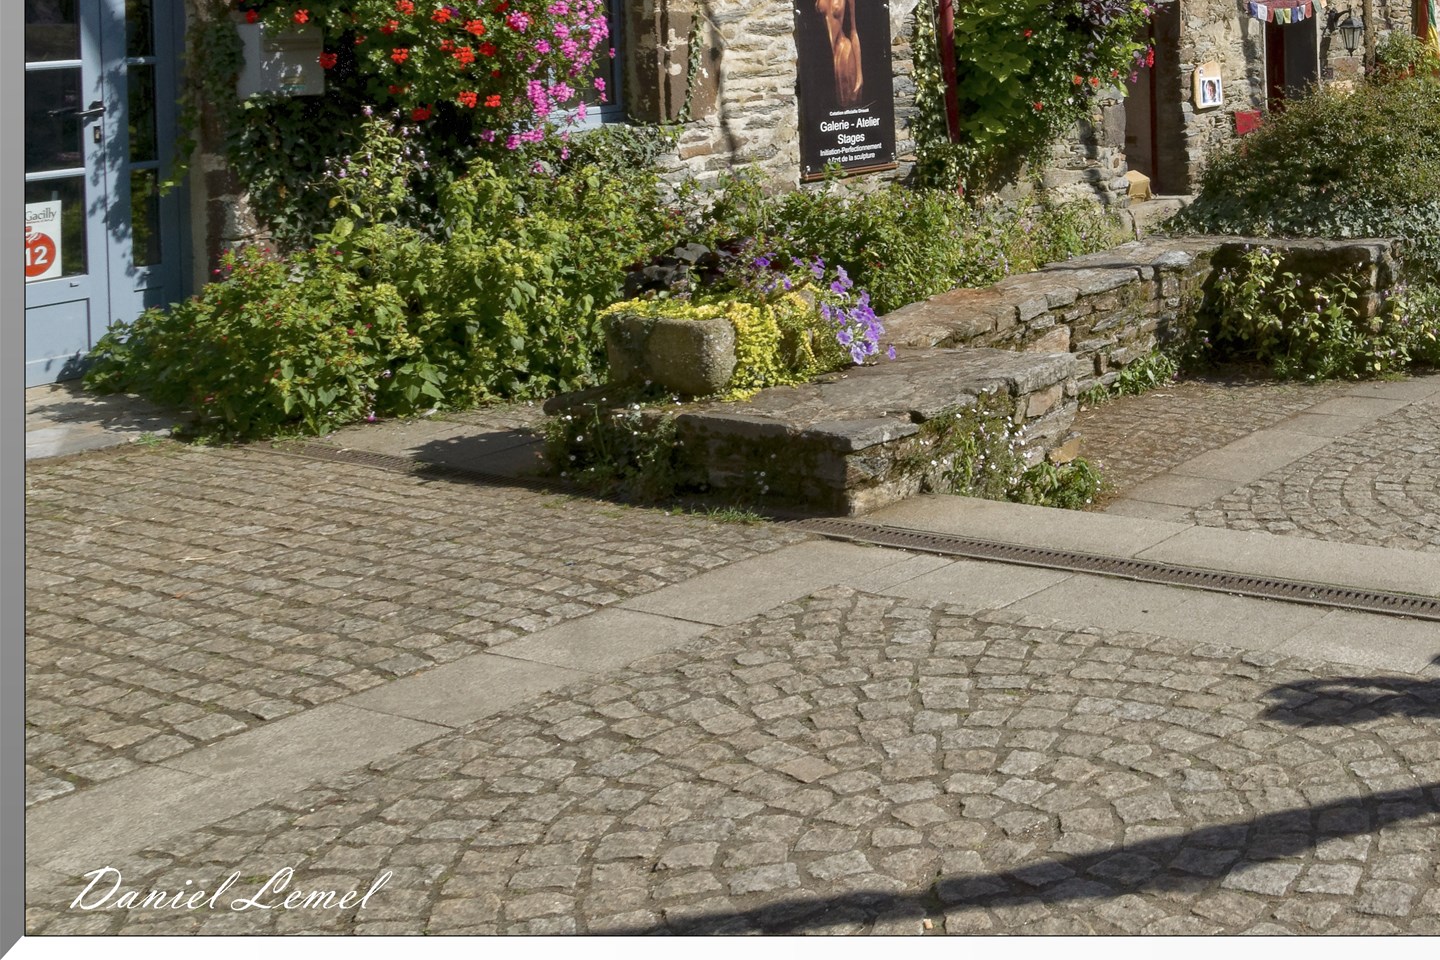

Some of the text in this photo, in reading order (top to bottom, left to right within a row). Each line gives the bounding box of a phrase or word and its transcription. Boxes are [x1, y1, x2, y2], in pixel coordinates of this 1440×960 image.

[820, 119, 850, 133] Galerie
[856, 116, 880, 129] Atelier
[837, 133, 866, 146] Stages
[854, 152, 876, 161] sculpture
[26, 207, 57, 222] Gacilly
